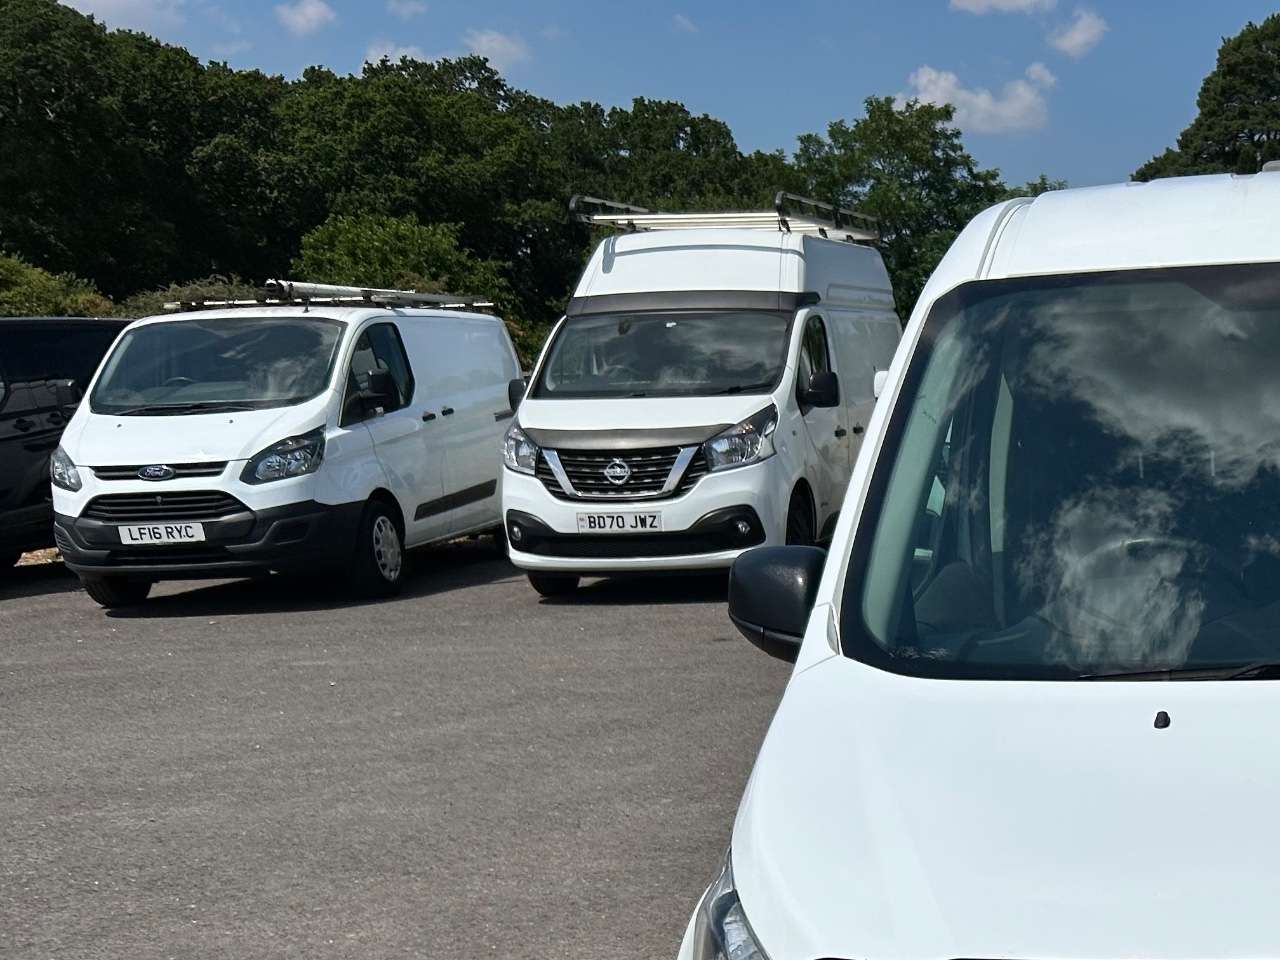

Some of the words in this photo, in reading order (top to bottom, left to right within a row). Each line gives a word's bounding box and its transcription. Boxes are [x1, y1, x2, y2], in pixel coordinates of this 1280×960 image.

[587, 515, 625, 529] BD70
[630, 515, 658, 529] JWZ
[127, 527, 163, 541] LF16
[164, 525, 194, 539] RYC
